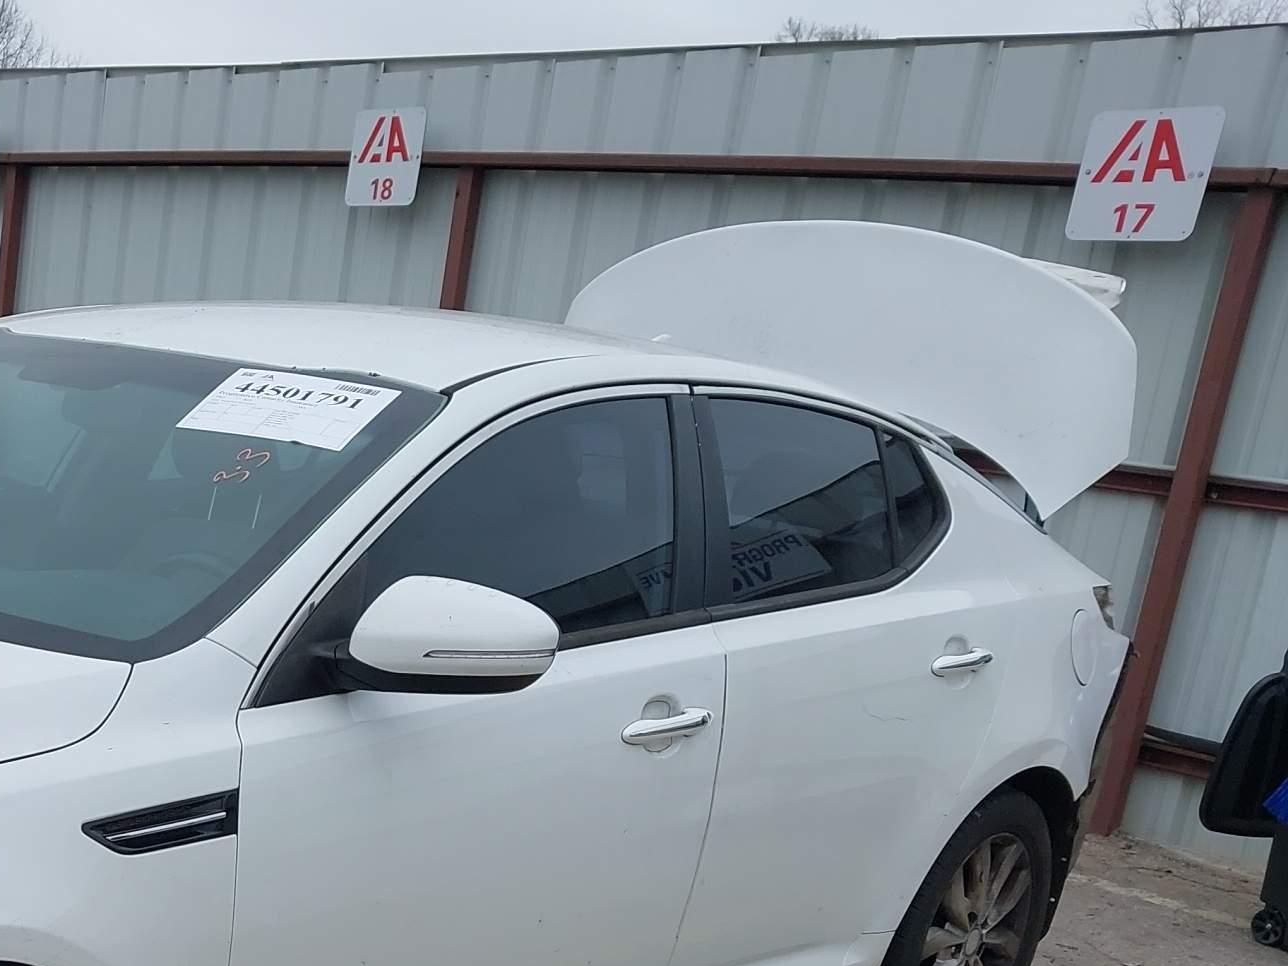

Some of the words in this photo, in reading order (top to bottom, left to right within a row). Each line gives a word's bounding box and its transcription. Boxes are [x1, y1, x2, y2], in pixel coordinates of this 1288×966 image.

[371, 178, 393, 201] 18
[1113, 203, 1155, 233] 17
[234, 382, 363, 409] 44501791
